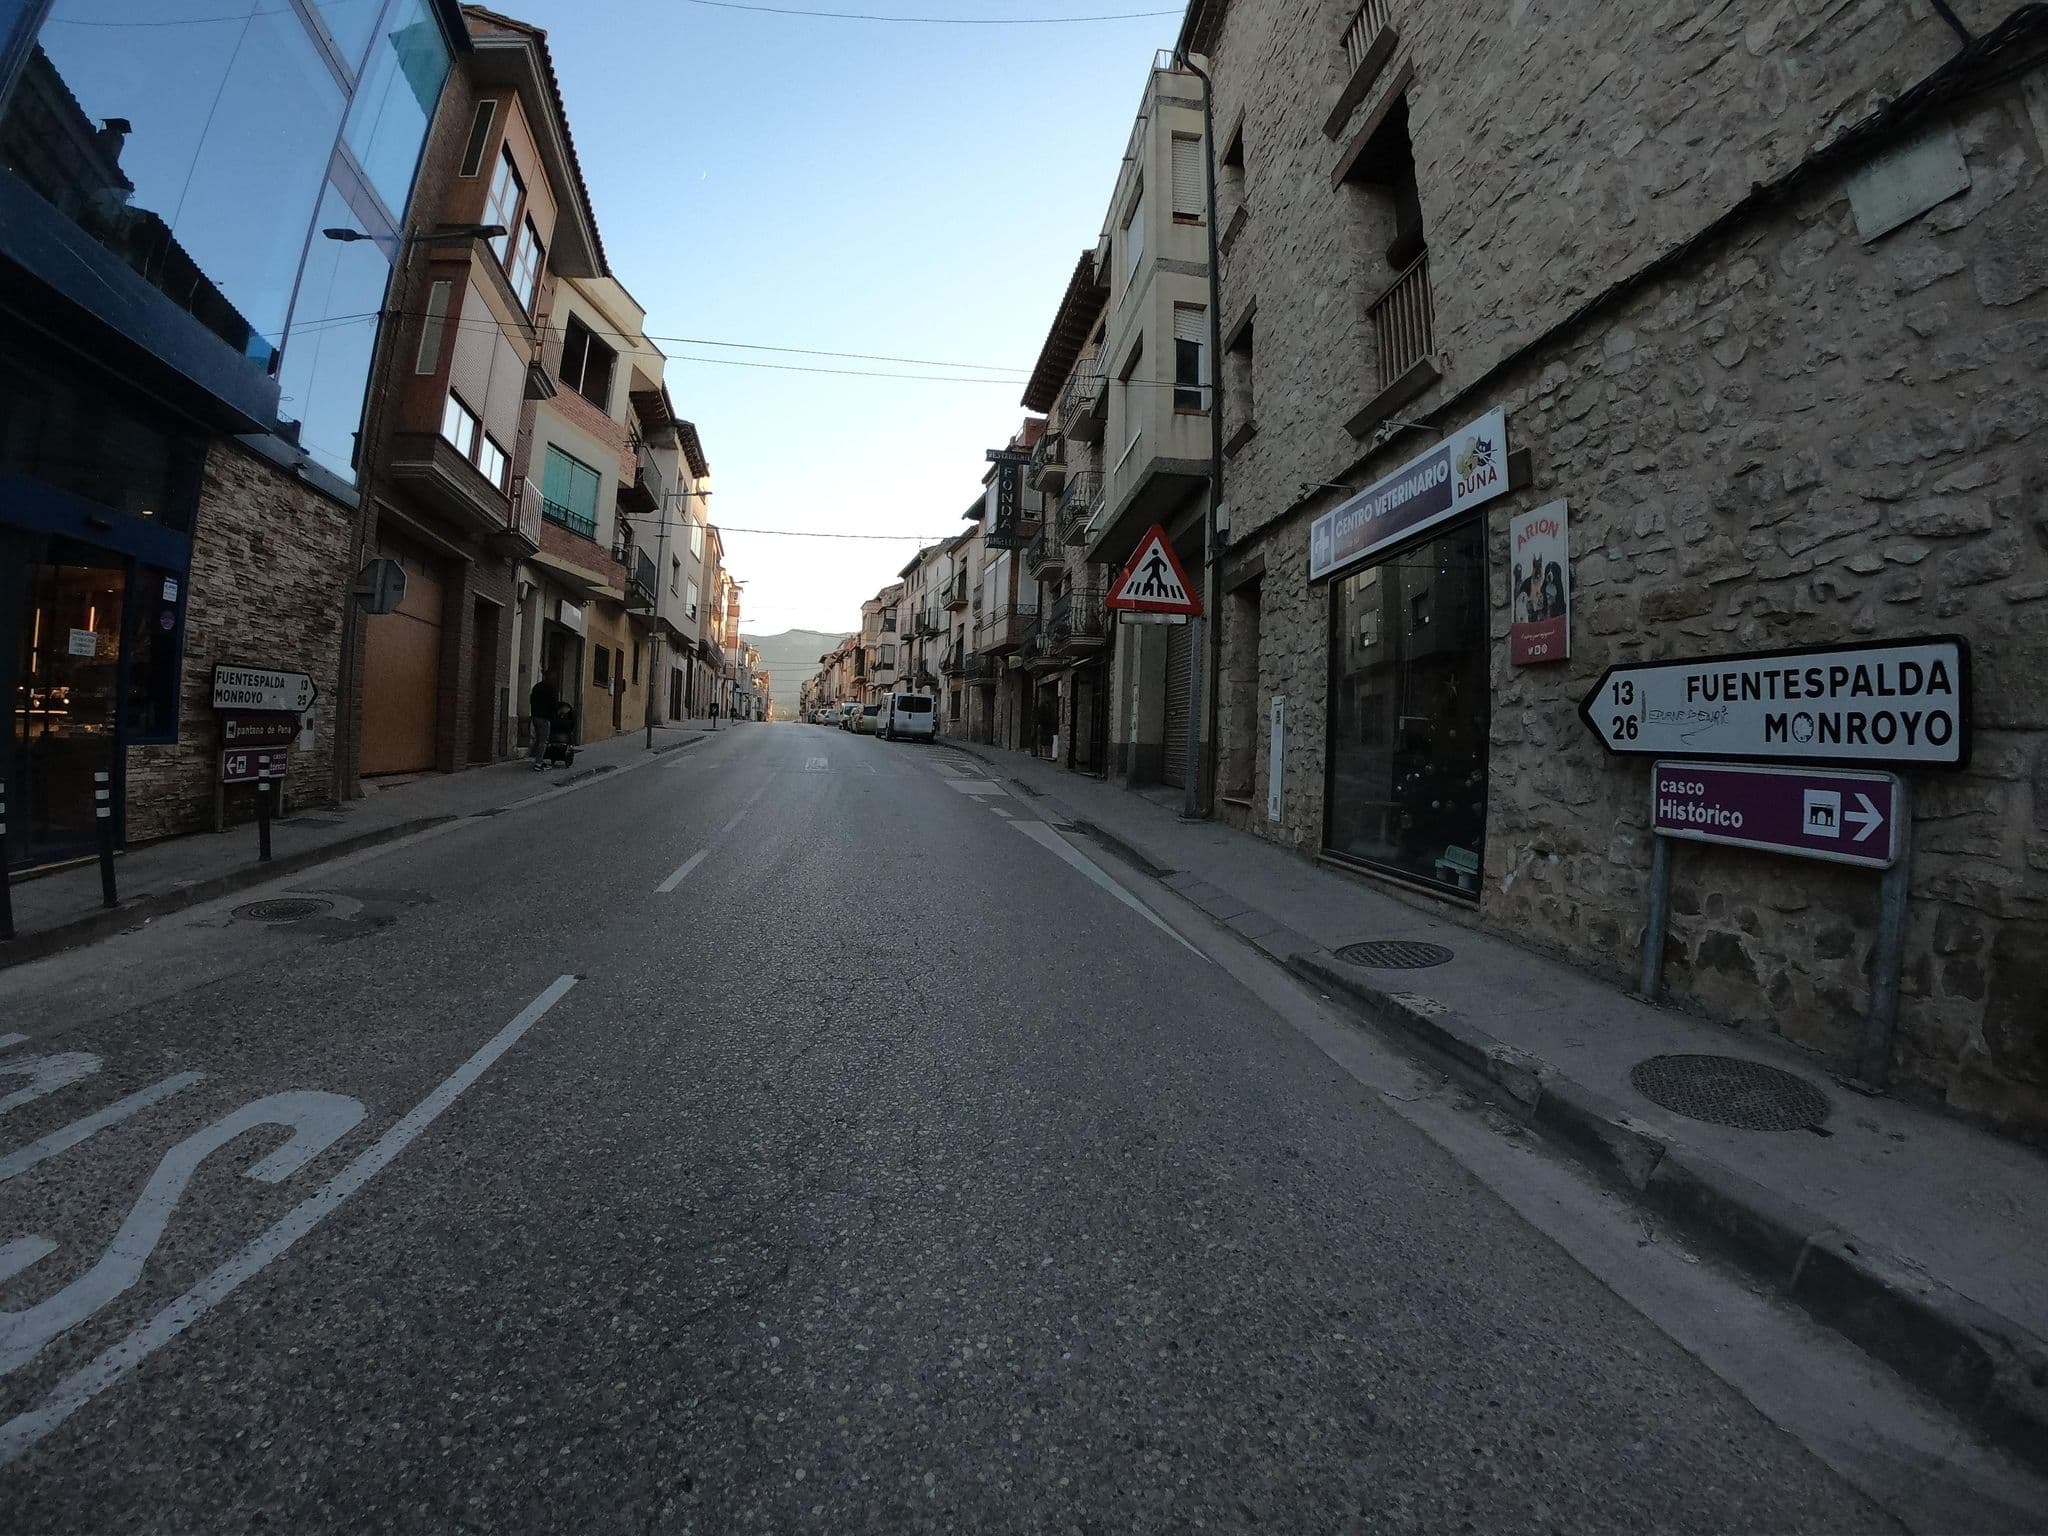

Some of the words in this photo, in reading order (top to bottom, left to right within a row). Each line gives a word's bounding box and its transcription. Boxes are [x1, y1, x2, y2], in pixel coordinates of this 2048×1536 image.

[1000, 467, 1013, 529] FONDA
[1336, 504, 1371, 537] CENTRO
[1375, 460, 1448, 517] VETERINARIO
[1458, 466, 1498, 499] DUNA
[1517, 519, 1559, 553] ARION
[215, 689, 263, 704] MONROYO
[298, 695, 307, 706] 25
[216, 671, 285, 688] FUENTESPALDA
[301, 680, 308, 691] 13
[1612, 681, 1634, 706] 13
[1687, 660, 1952, 703] FUENTESPALDA
[237, 725, 264, 736] pantano
[267, 726, 275, 735] de
[1612, 715, 1638, 740] 26
[1765, 709, 1952, 746] MONROYO
[1660, 780, 1704, 796] casco
[1659, 799, 1743, 828] Histórico
